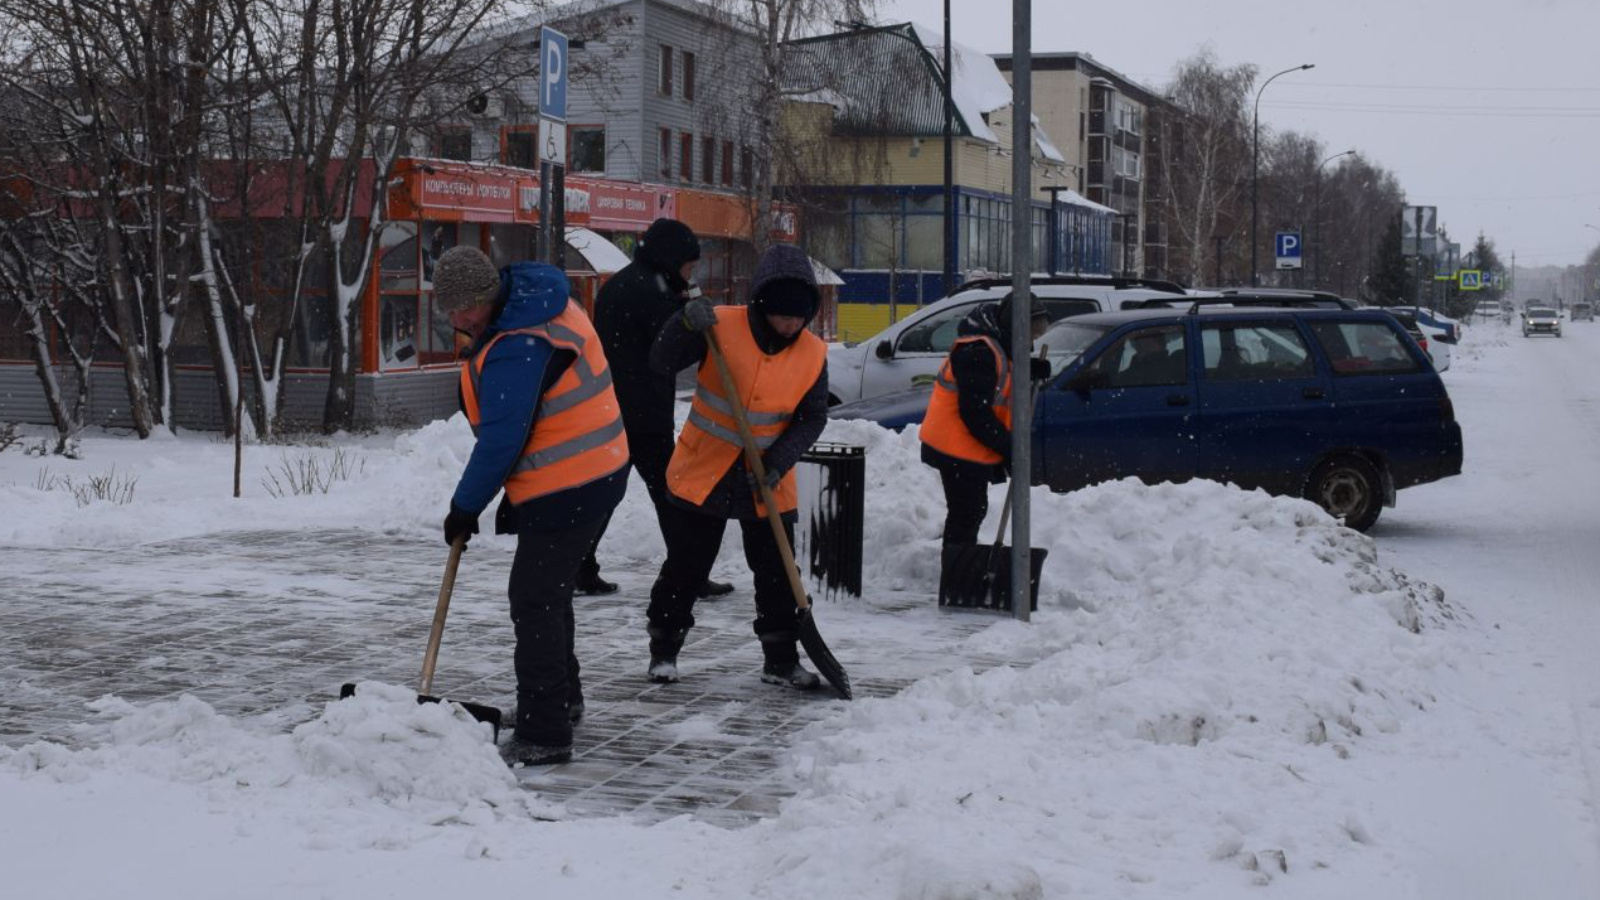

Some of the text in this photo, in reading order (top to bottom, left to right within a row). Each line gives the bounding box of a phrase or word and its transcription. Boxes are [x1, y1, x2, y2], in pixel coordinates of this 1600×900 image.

[546, 39, 562, 106] P
[425, 179, 474, 197] КОМПЬЮТЕРЫ
[1282, 235, 1297, 256] P
